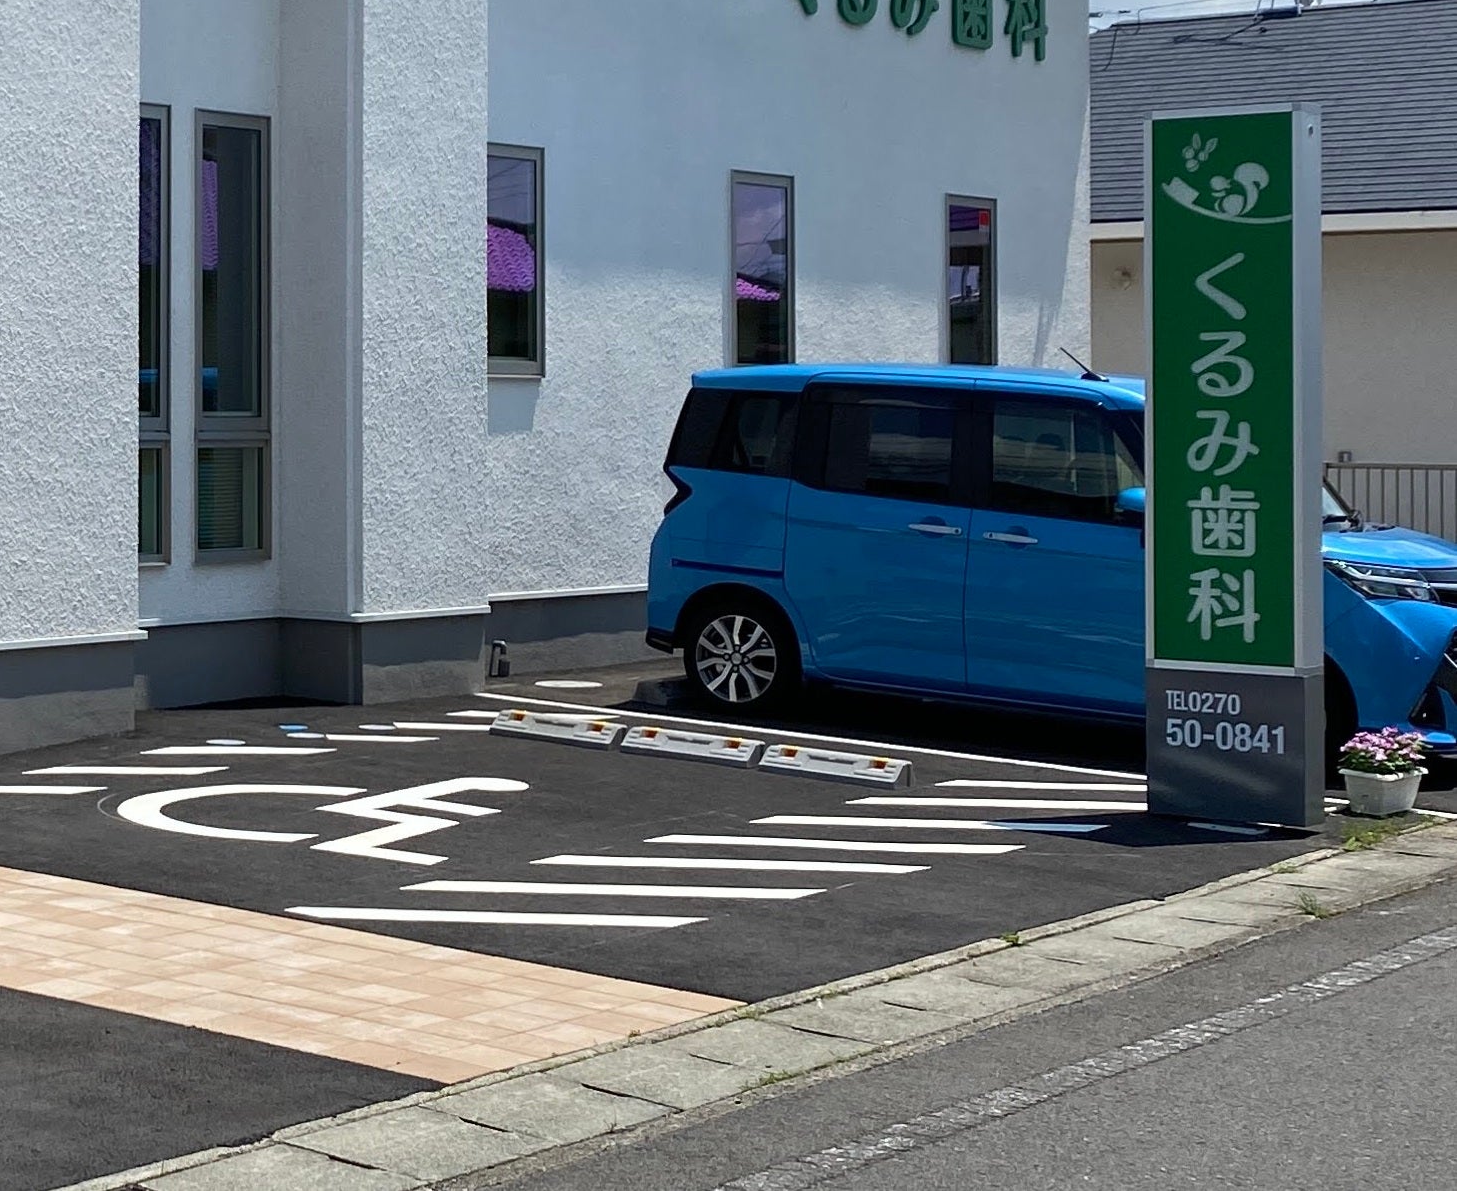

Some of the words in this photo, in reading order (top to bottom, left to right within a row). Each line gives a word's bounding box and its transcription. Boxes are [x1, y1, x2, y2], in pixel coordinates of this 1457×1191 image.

[1186, 252, 1261, 644] くるみ歯科
[1165, 718, 1285, 755] 50-0841
